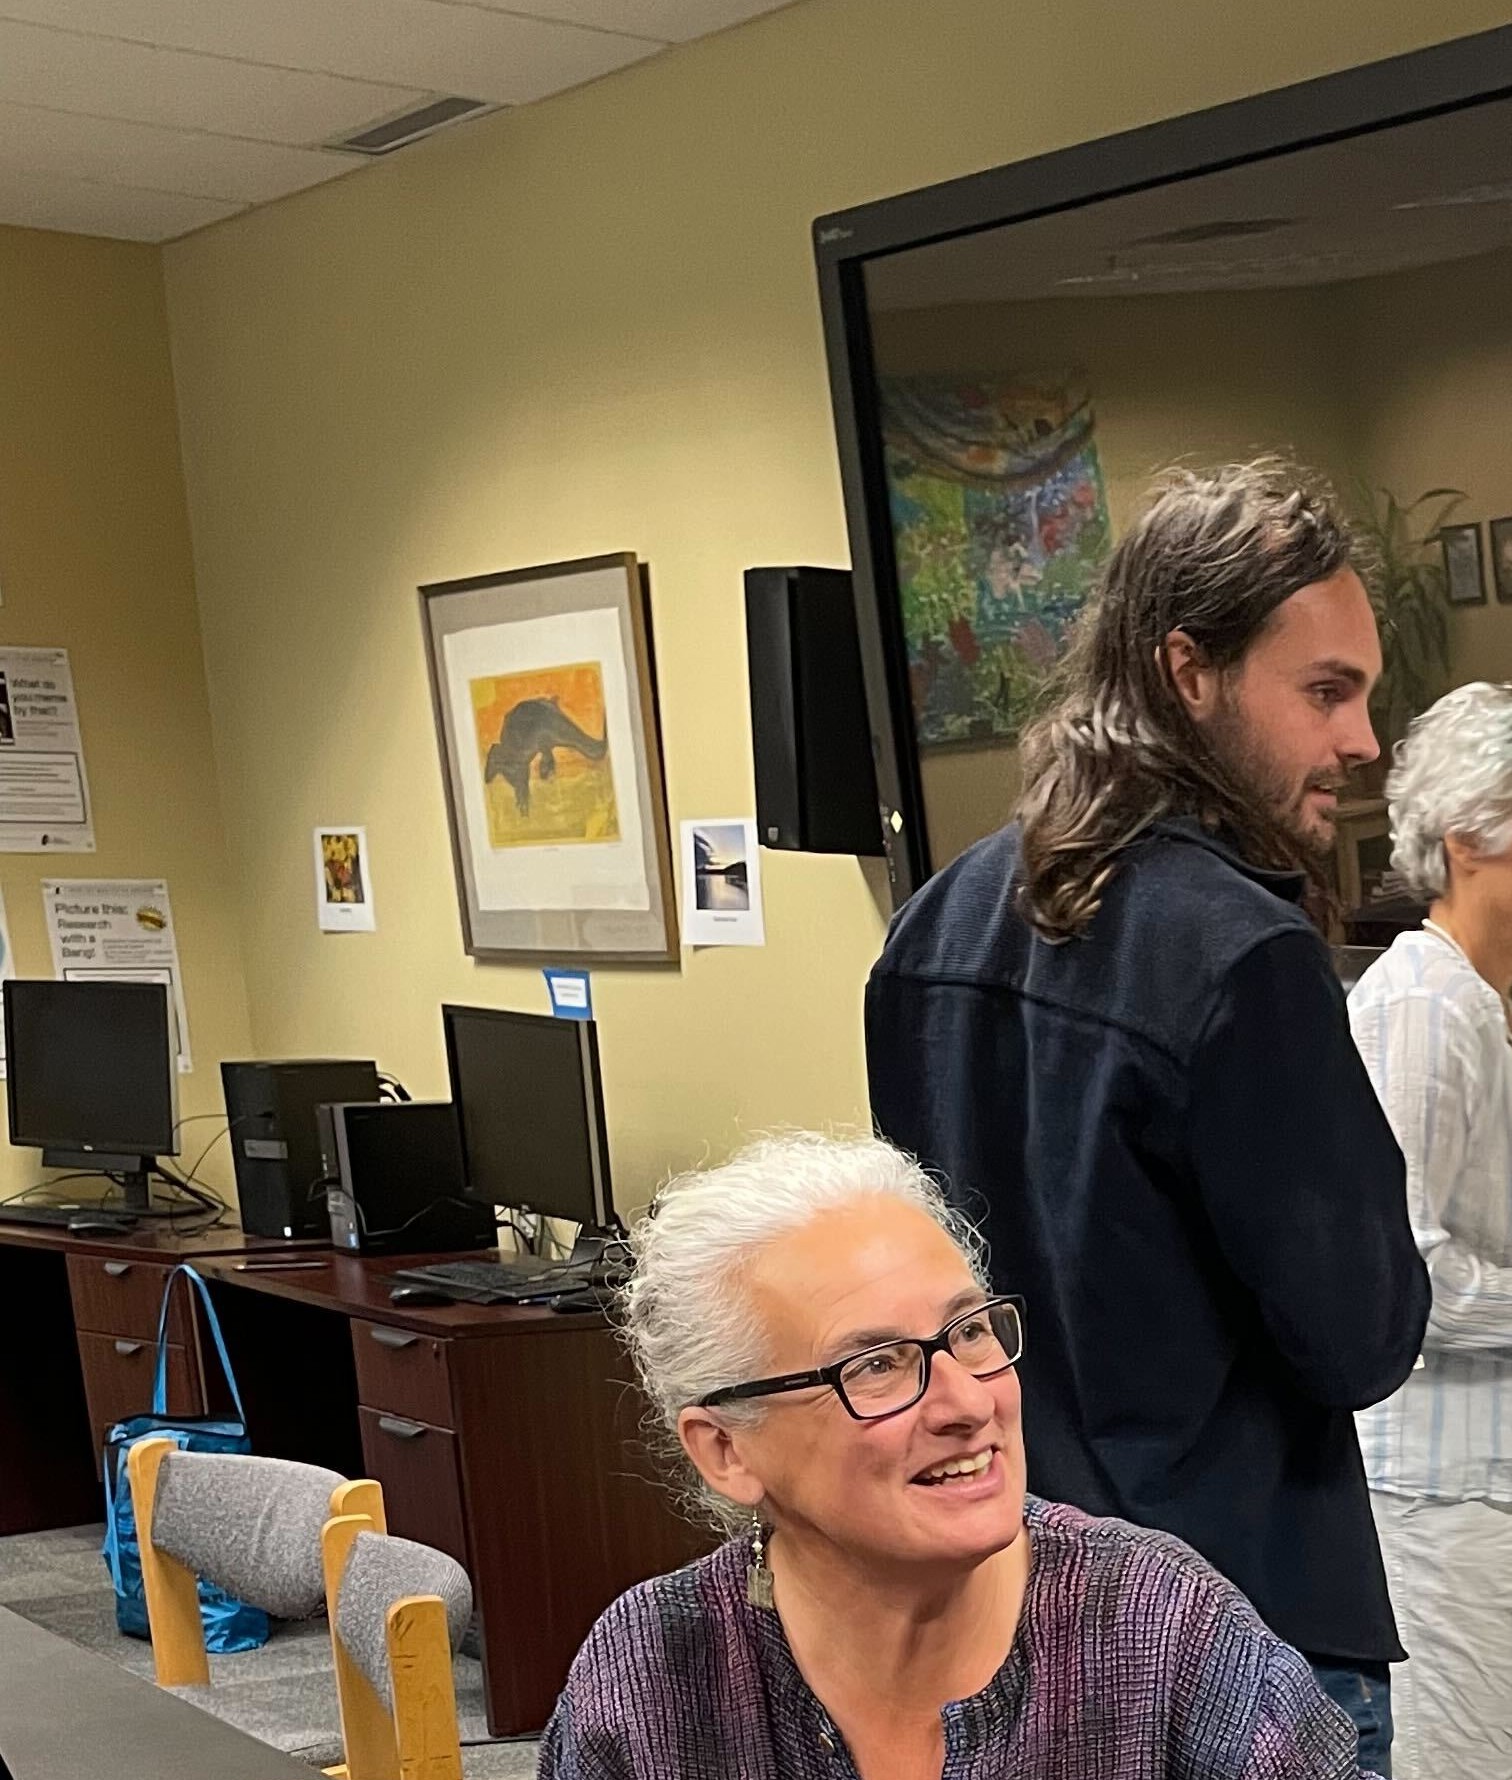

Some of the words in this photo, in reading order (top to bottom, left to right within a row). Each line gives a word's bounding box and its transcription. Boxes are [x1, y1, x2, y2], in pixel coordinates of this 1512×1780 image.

[55, 903, 99, 915] Picture
[57, 919, 112, 929] Research
[60, 935, 87, 943] with
